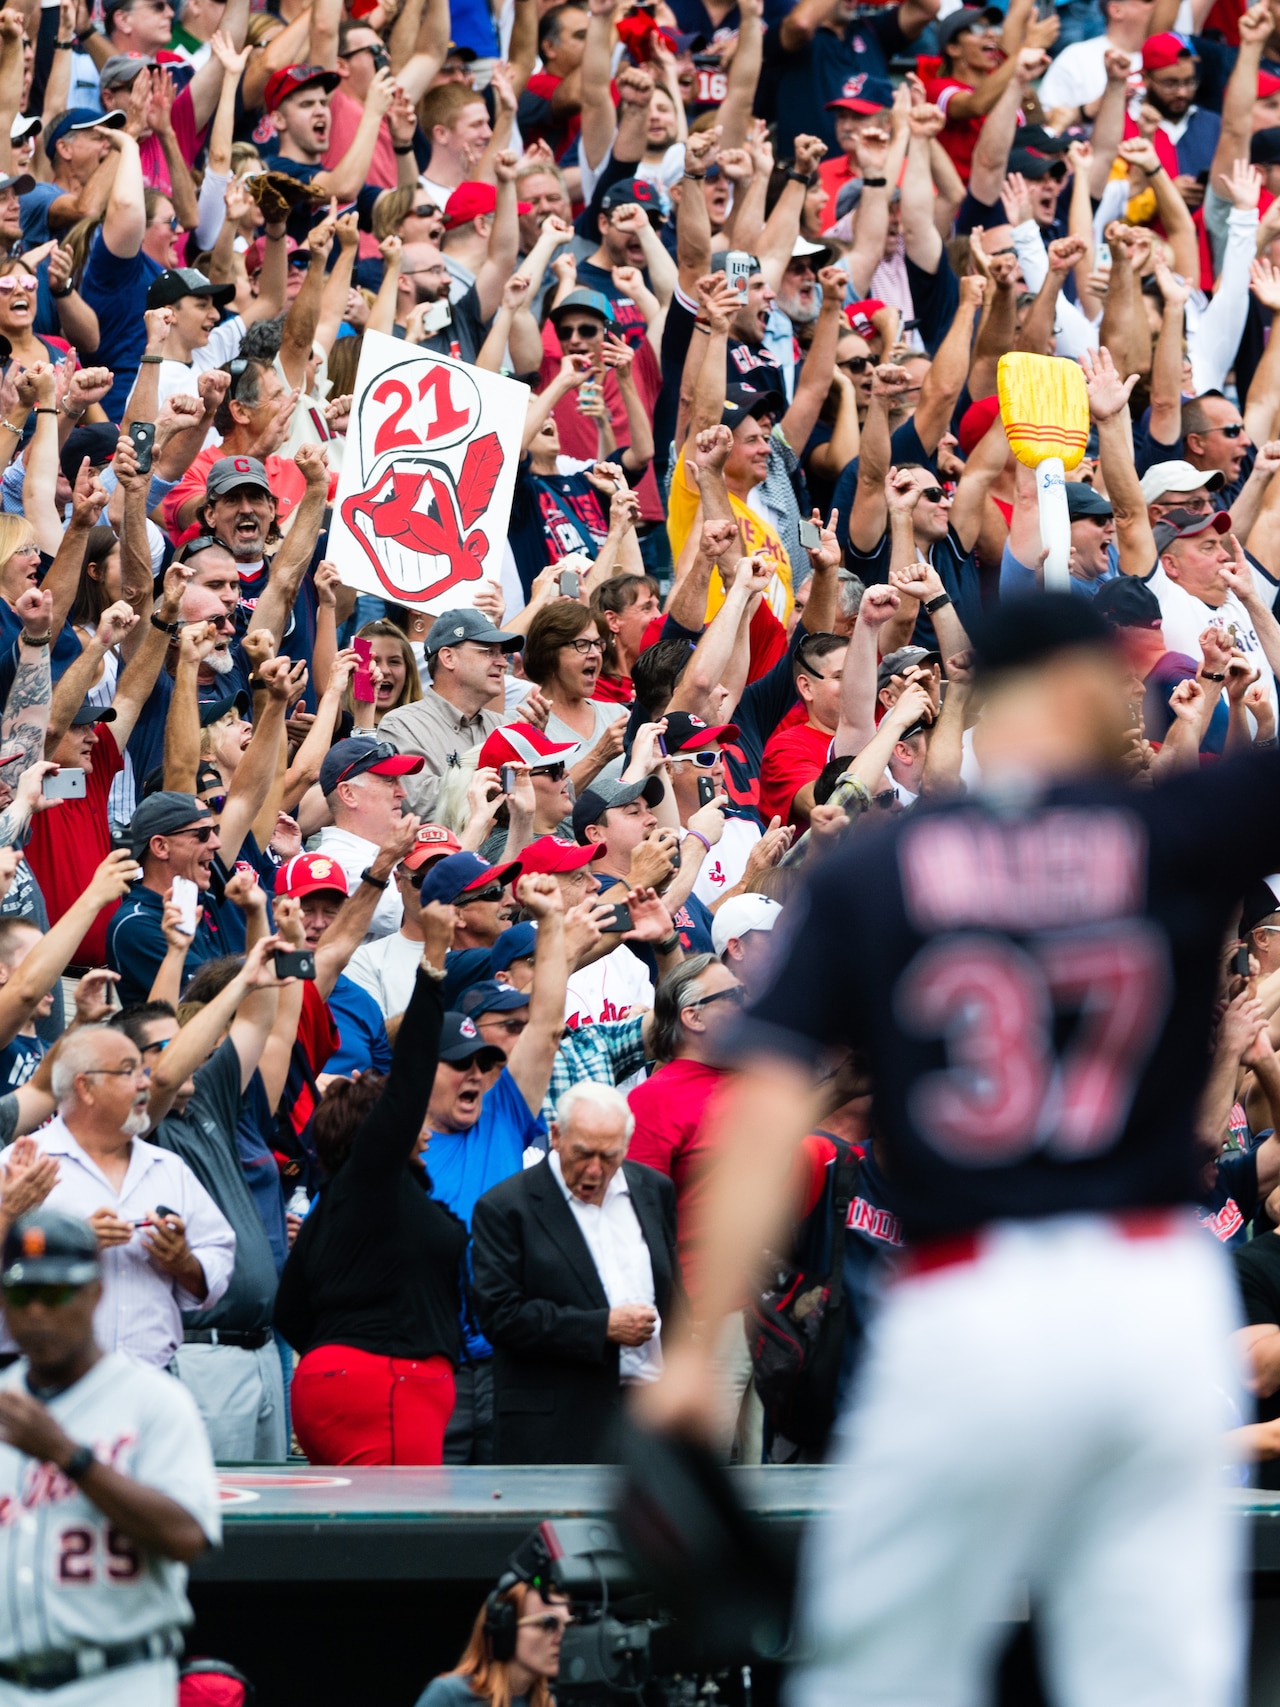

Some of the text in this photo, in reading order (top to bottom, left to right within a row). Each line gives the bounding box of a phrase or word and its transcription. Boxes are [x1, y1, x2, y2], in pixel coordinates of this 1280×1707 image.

[698, 73, 728, 101] 16
[632, 180, 652, 201] C
[372, 364, 470, 457] 21
[233, 457, 251, 473] C
[893, 922, 1172, 1168] 37
[60, 1529, 142, 1583] 25
